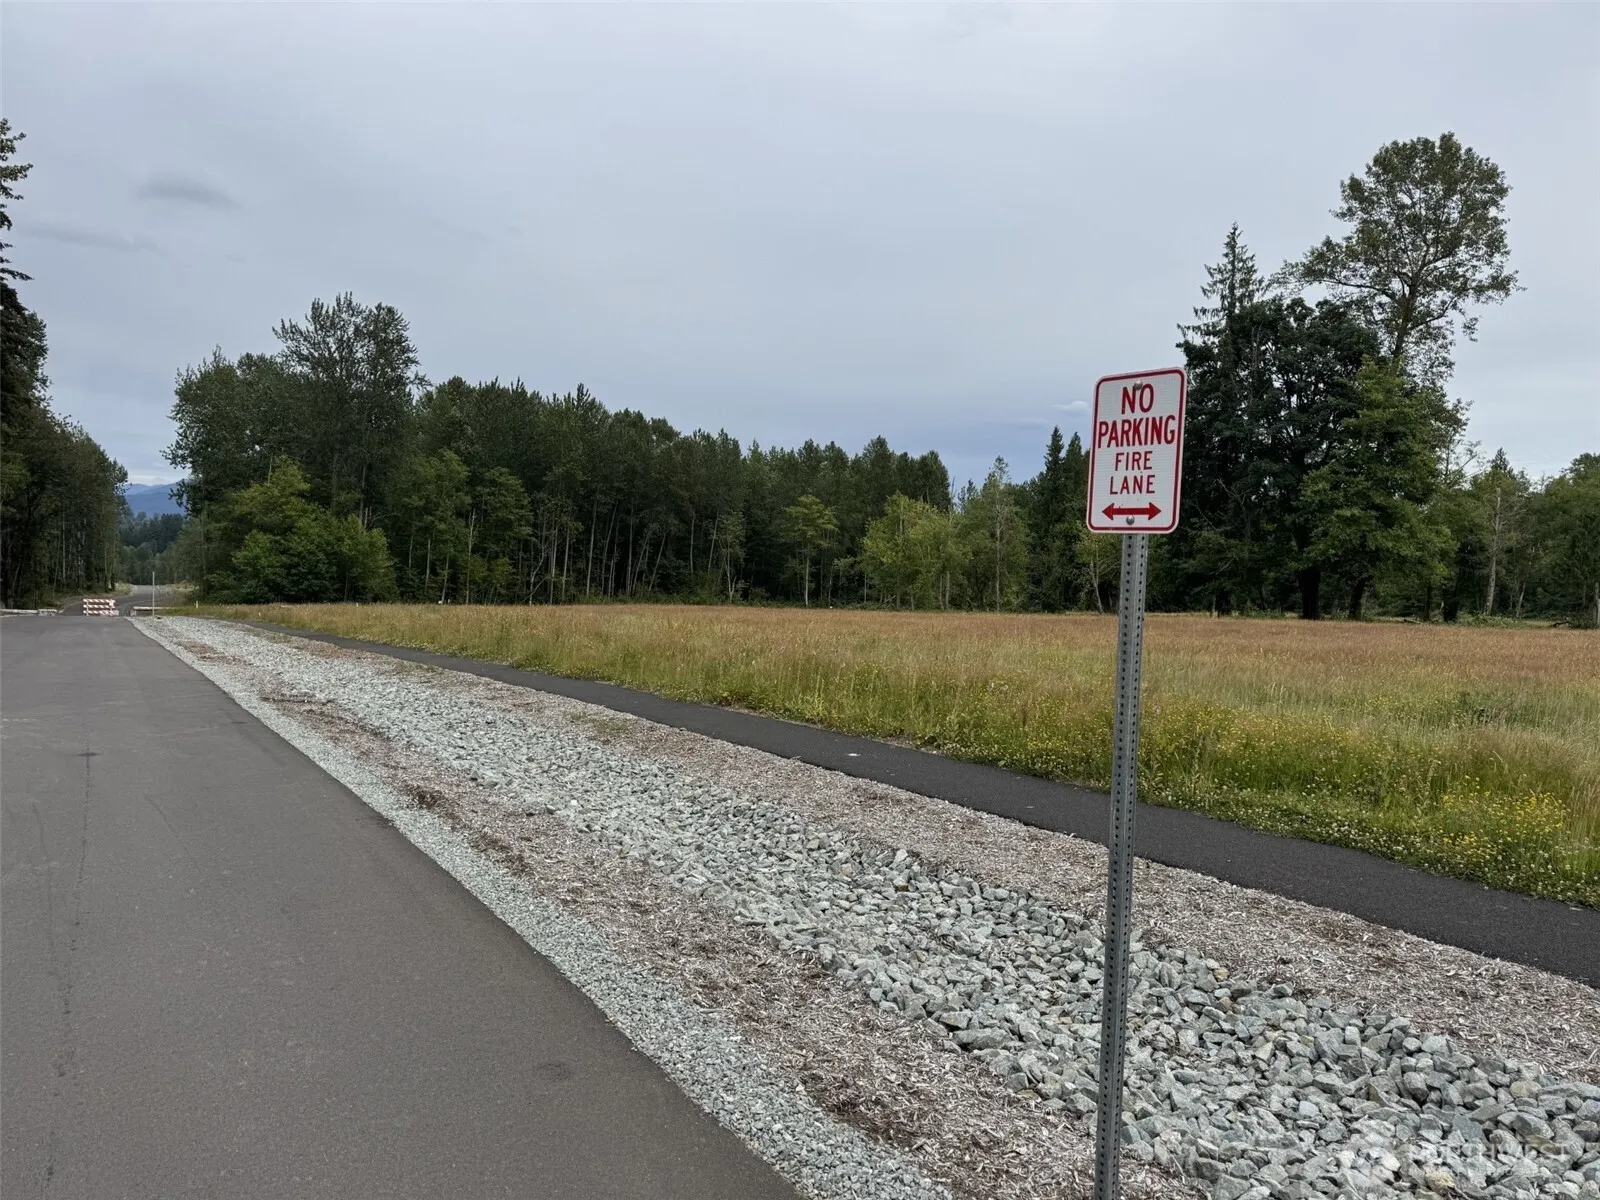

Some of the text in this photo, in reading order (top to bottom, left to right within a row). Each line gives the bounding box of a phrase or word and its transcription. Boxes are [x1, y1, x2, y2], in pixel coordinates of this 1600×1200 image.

[1121, 383, 1154, 414] NO
[1097, 415, 1176, 449] PARKING
[1115, 451, 1153, 471] FIRE
[1109, 474, 1156, 495] LANE
